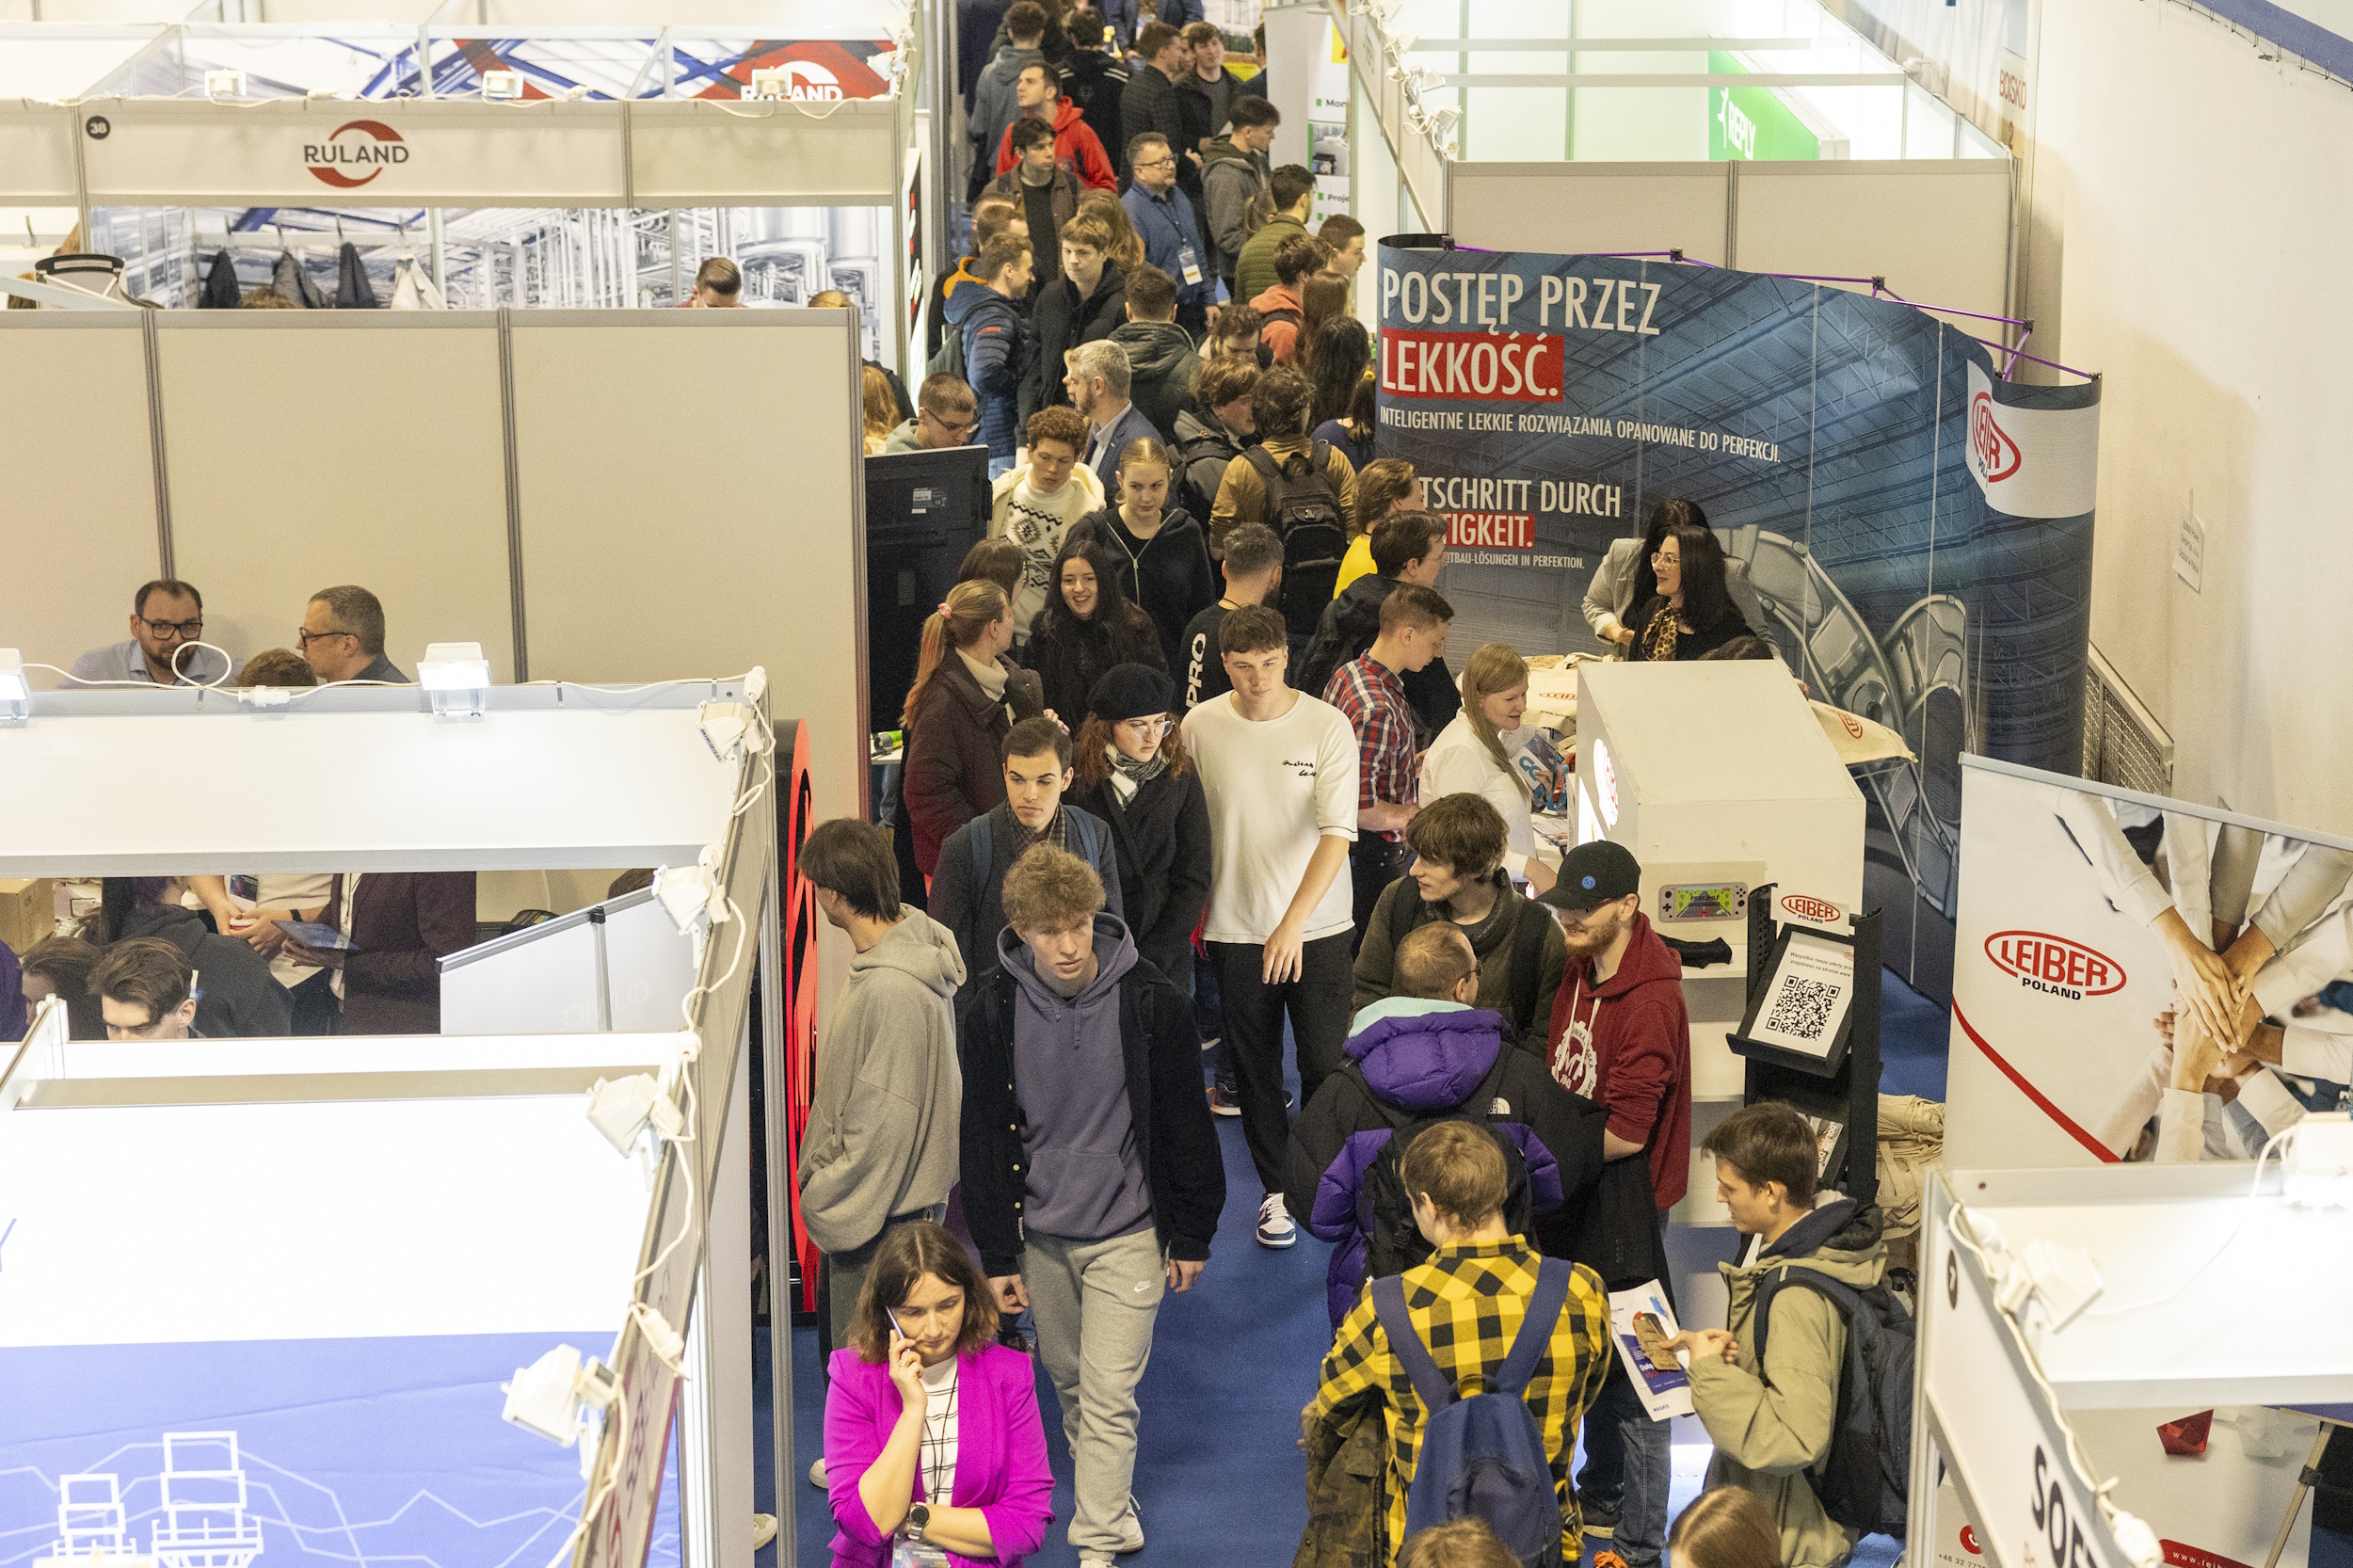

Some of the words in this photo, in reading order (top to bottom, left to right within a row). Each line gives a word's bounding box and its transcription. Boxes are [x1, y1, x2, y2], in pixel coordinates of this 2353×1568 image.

[1999, 69, 2026, 110] BOISKO
[90, 122, 106, 135] 38
[1728, 100, 1756, 160] REPLY
[2008, 120, 2013, 151] 2
[304, 145, 409, 164] RULAND
[1384, 267, 1524, 336] POSTĘP
[1540, 275, 1662, 336] PRZEZ
[1382, 330, 1559, 397] LEKKOŚĆ.
[1380, 406, 1464, 430] INTELIGENTNE
[1468, 412, 1513, 432] LEKKIE
[1518, 413, 1613, 438] ROZWIĄZANIA
[1617, 420, 1696, 448] OPANOWANE
[1699, 431, 1719, 451] DO
[1722, 434, 1782, 463] PERFEKCJI.
[1418, 476, 1532, 511] TSCHRITT
[1541, 480, 1621, 518] DURCH
[1440, 513, 1533, 548] TIGKEIT.
[1447, 551, 1518, 567] TBAU-LÖSUNGEN
[1521, 553, 1530, 567] IN
[1532, 555, 1585, 569] PERFEKTION.
[1186, 632, 1207, 709] PRO
[1788, 899, 1834, 919] LEIBER
[1798, 914, 1824, 924] POLAND
[2001, 940, 2109, 987] LEIBER
[2022, 977, 2082, 1001] POLAND
[1939, 1554, 1952, 1562] +48
[1955, 1558, 1965, 1566] 32
